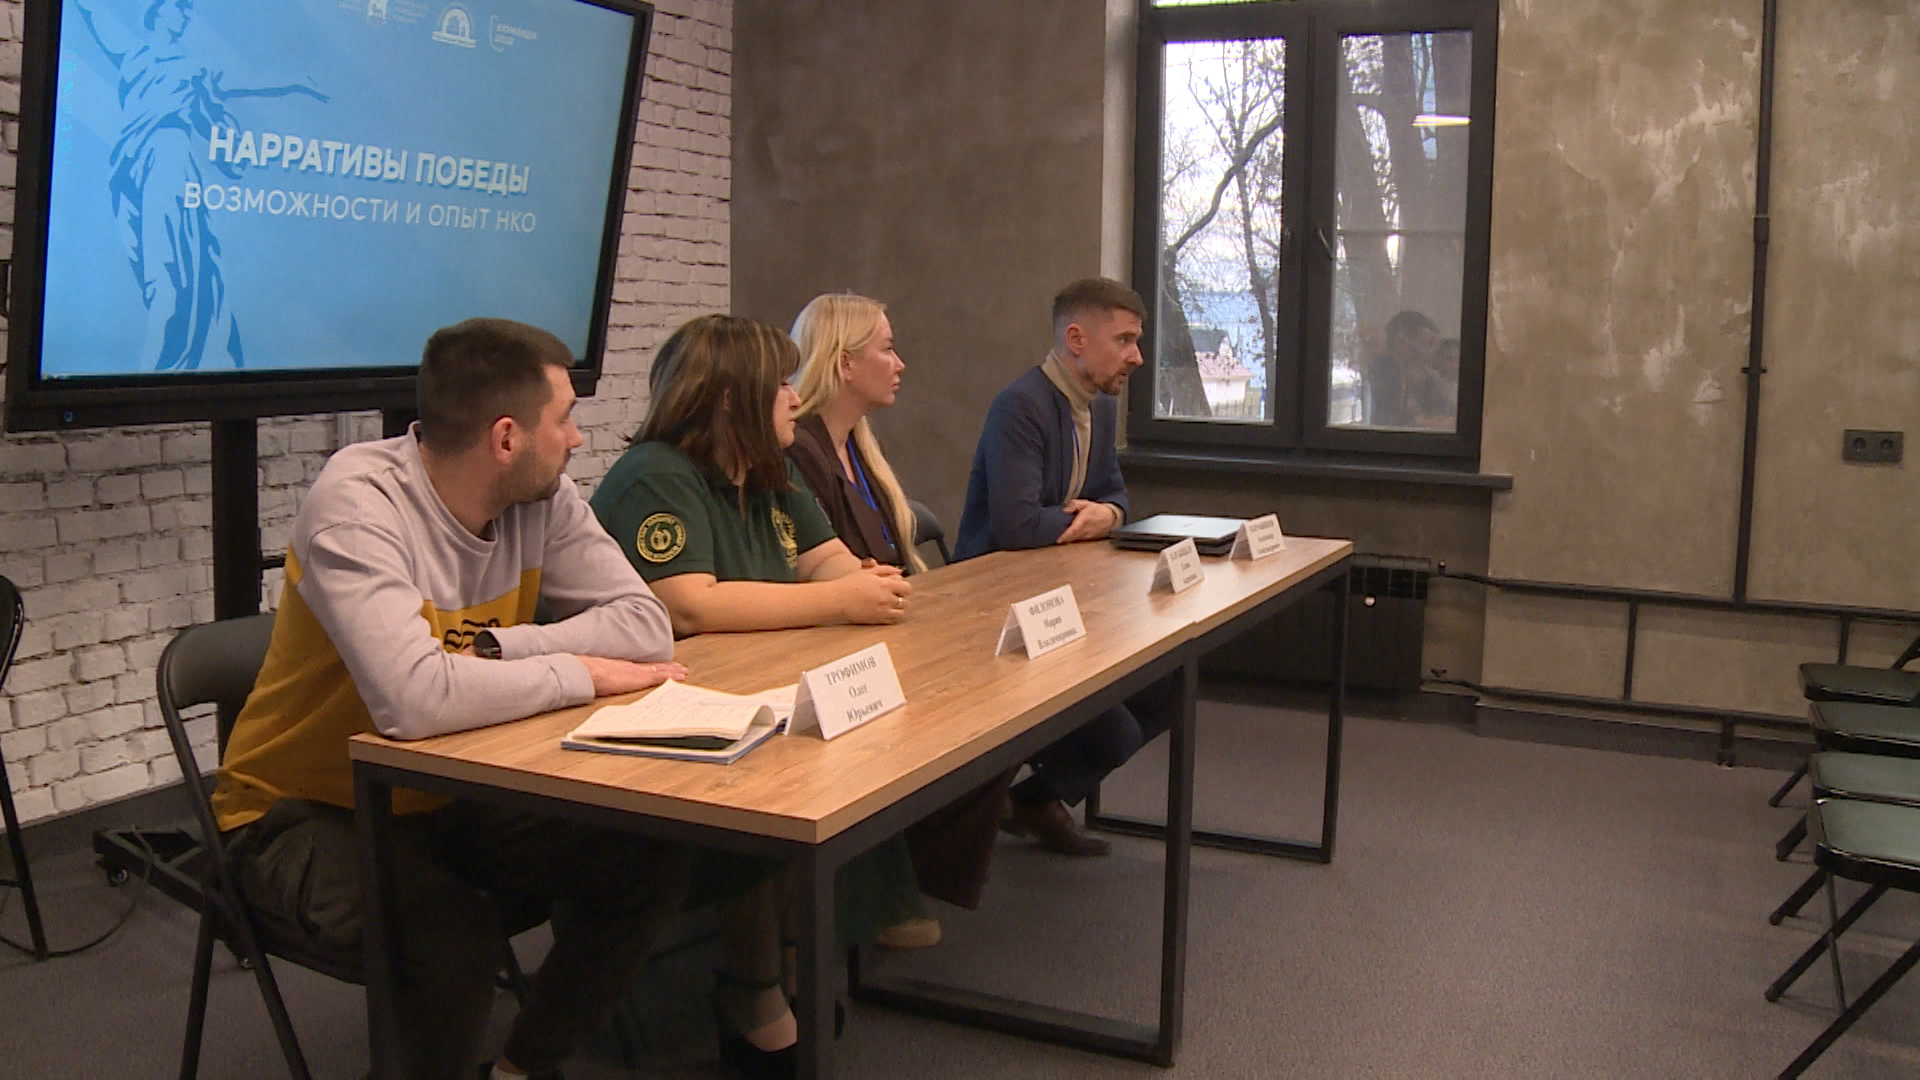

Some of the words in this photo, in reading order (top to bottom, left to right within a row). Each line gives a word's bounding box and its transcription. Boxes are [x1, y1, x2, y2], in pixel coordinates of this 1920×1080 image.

[208, 125, 408, 181] НАРРАТИВЫ
[415, 151, 530, 196] ПОБЕДЫ
[183, 182, 399, 223] ВОЗМОЖНОСТИ
[405, 203, 422, 224] И
[428, 204, 491, 230] ОПЫТ
[495, 209, 537, 233] НКО
[825, 655, 877, 686] ТРОФИМОВ
[848, 684, 868, 699] Олег
[846, 699, 884, 723] Юрьевич
